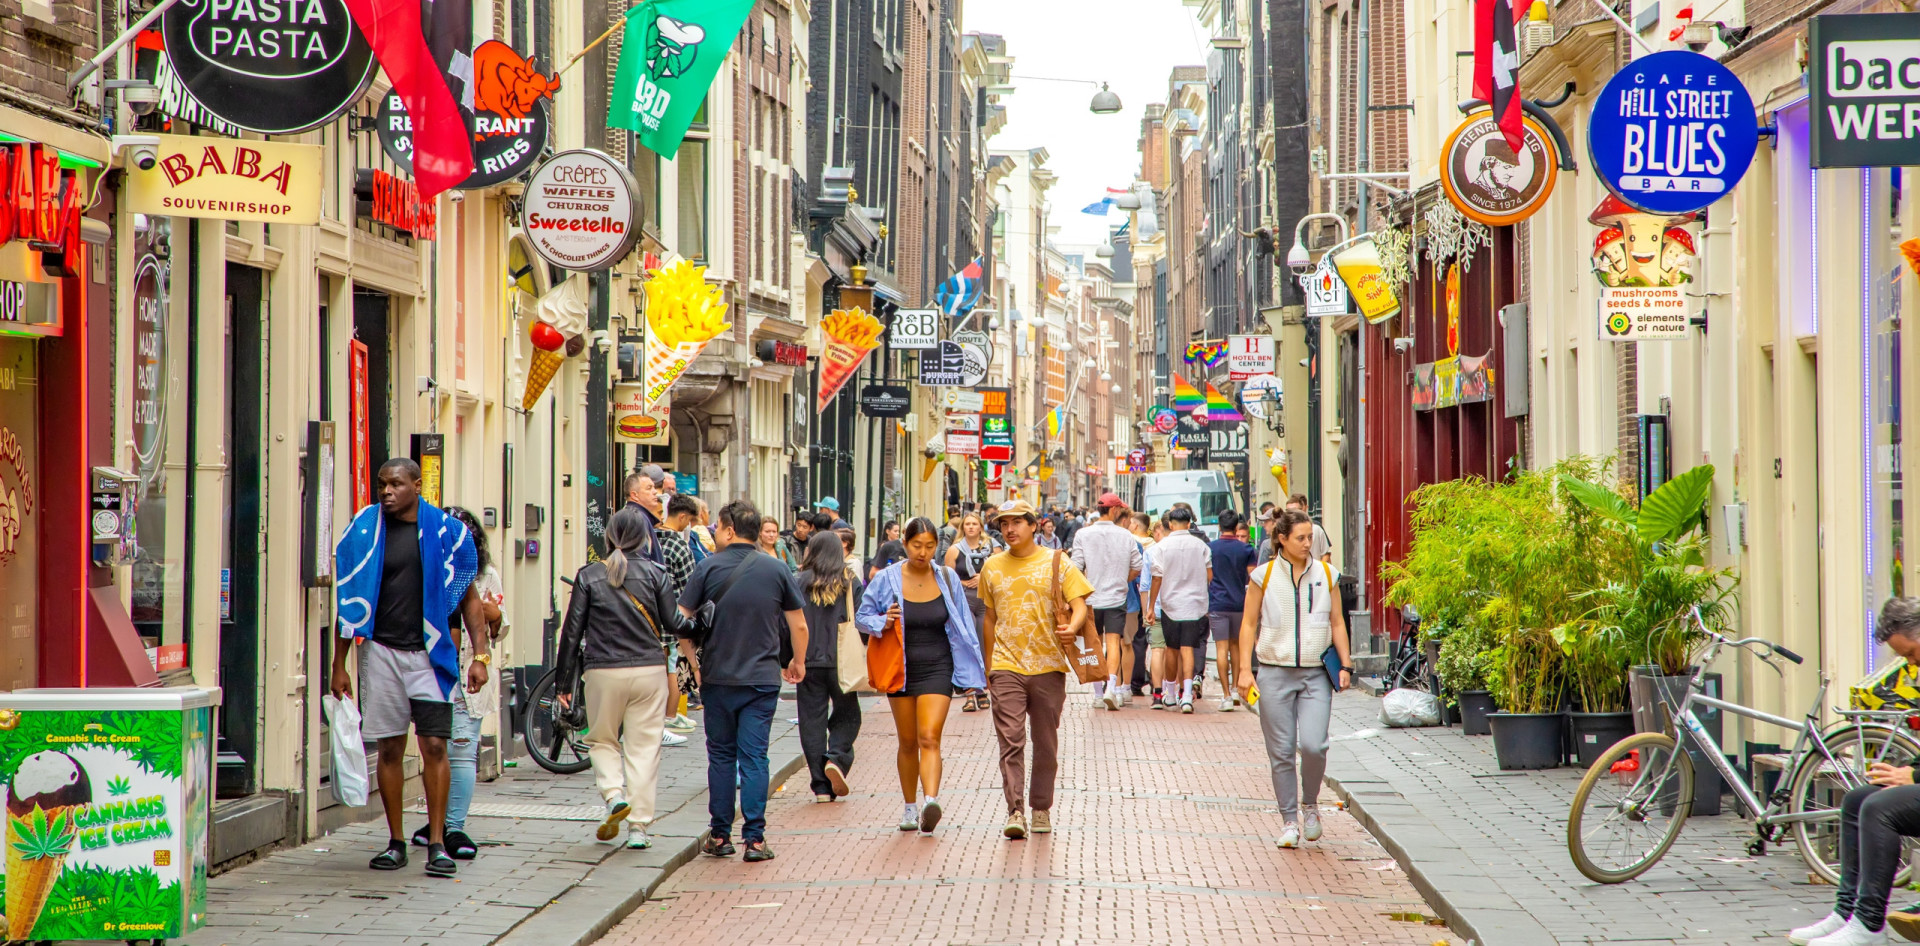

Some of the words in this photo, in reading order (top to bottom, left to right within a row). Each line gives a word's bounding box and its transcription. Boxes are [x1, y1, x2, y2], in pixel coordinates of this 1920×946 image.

[211, 0, 328, 24] PASTA
[211, 27, 328, 60] PASTA
[1634, 73, 1717, 85] CAFE
[1665, 89, 1733, 119] STREET
[389, 115, 535, 133] RERANT
[1461, 122, 1500, 148] HENRI
[1523, 132, 1541, 153] LIG
[1623, 120, 1726, 176] BLUES
[482, 138, 531, 174] RIBS
[159, 146, 291, 195] BABA
[543, 187, 615, 198] WAFFLES
[1642, 178, 1700, 190] BAR
[163, 197, 291, 215] SOUVENIRSHOP
[547, 201, 610, 212] CHURROS
[1470, 193, 1496, 209] SINCE
[1499, 197, 1522, 209] 1974
[529, 212, 624, 234] Sweetella
[541, 237, 550, 249] WE
[549, 246, 586, 261] CHOCOLIZE
[587, 243, 610, 259] THINGS
[555, 235, 597, 243] AMSTERDAM
[1314, 291, 1340, 302] NOT
[1607, 299, 1640, 308] seeds
[1644, 299, 1651, 307] &
[1612, 289, 1678, 297] mushrooms
[139, 296, 157, 322] HOME
[1637, 314, 1685, 322] elements
[139, 332, 157, 357] MADE
[138, 365, 156, 390] PASTA
[663, 359, 686, 382] Tom
[135, 400, 140, 423] &
[141, 400, 158, 424] PIZZA
[1774, 458, 1782, 479] 52
[46, 733, 89, 742] Cannabis
[93, 734, 107, 743] Ice
[110, 734, 141, 743] Cream
[74, 795, 166, 829] CANNABIS
[79, 826, 108, 851] ICE
[111, 817, 172, 845] CREAM
[103, 922, 116, 930] Dr
[118, 922, 165, 931] Greenlove
